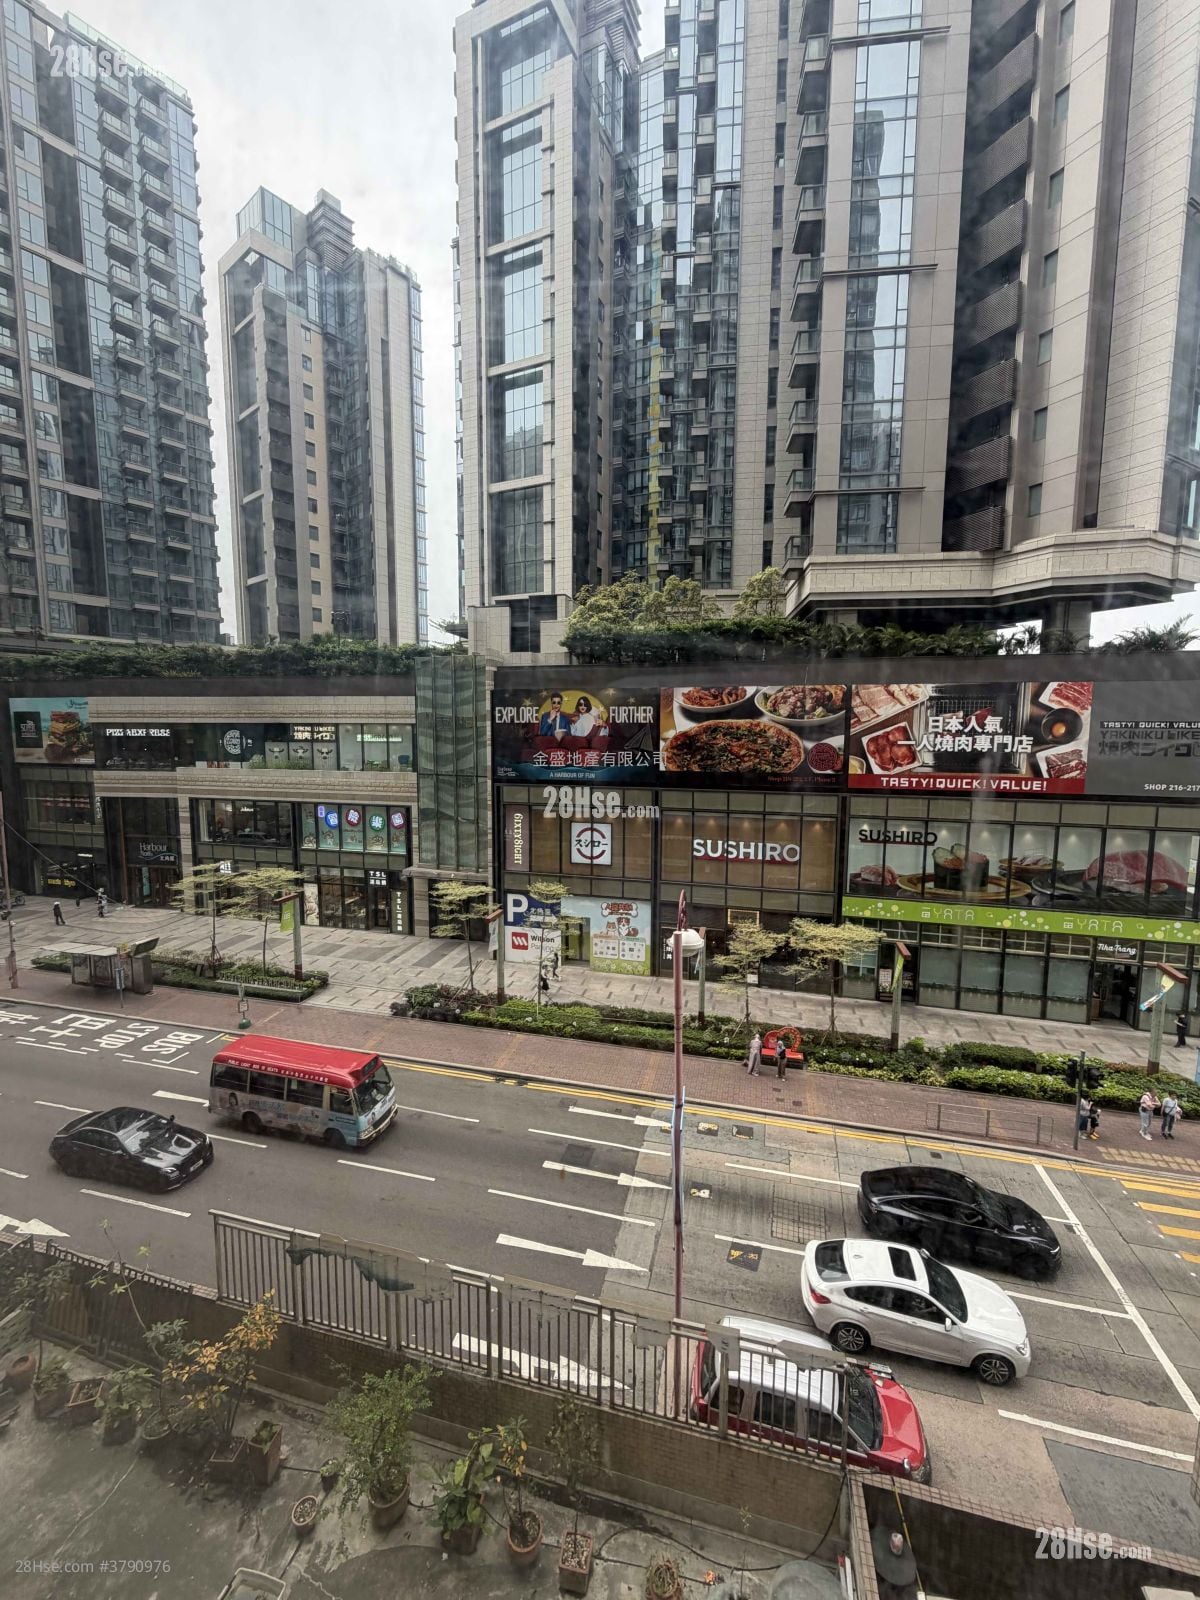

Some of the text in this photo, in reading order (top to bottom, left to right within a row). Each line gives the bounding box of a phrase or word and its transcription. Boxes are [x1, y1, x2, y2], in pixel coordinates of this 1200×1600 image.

[495, 706, 654, 724] EXPLORE FURTHER
[928, 715, 1004, 733] 日本人氣
[896, 734, 1034, 753] 一人燒肉專門店
[1100, 730, 1164, 740] YAKINIKU
[880, 777, 1047, 791] TASTY! QUICK! VALUE!
[1144, 783, 1167, 791] SHOP
[575, 838, 609, 848] スシロー
[858, 828, 938, 845] SUSHIRO
[692, 838, 800, 862] SUSHIRO
[507, 893, 529, 923] P
[94, 1022, 161, 1049] STOP
[141, 1031, 205, 1055] BUS
